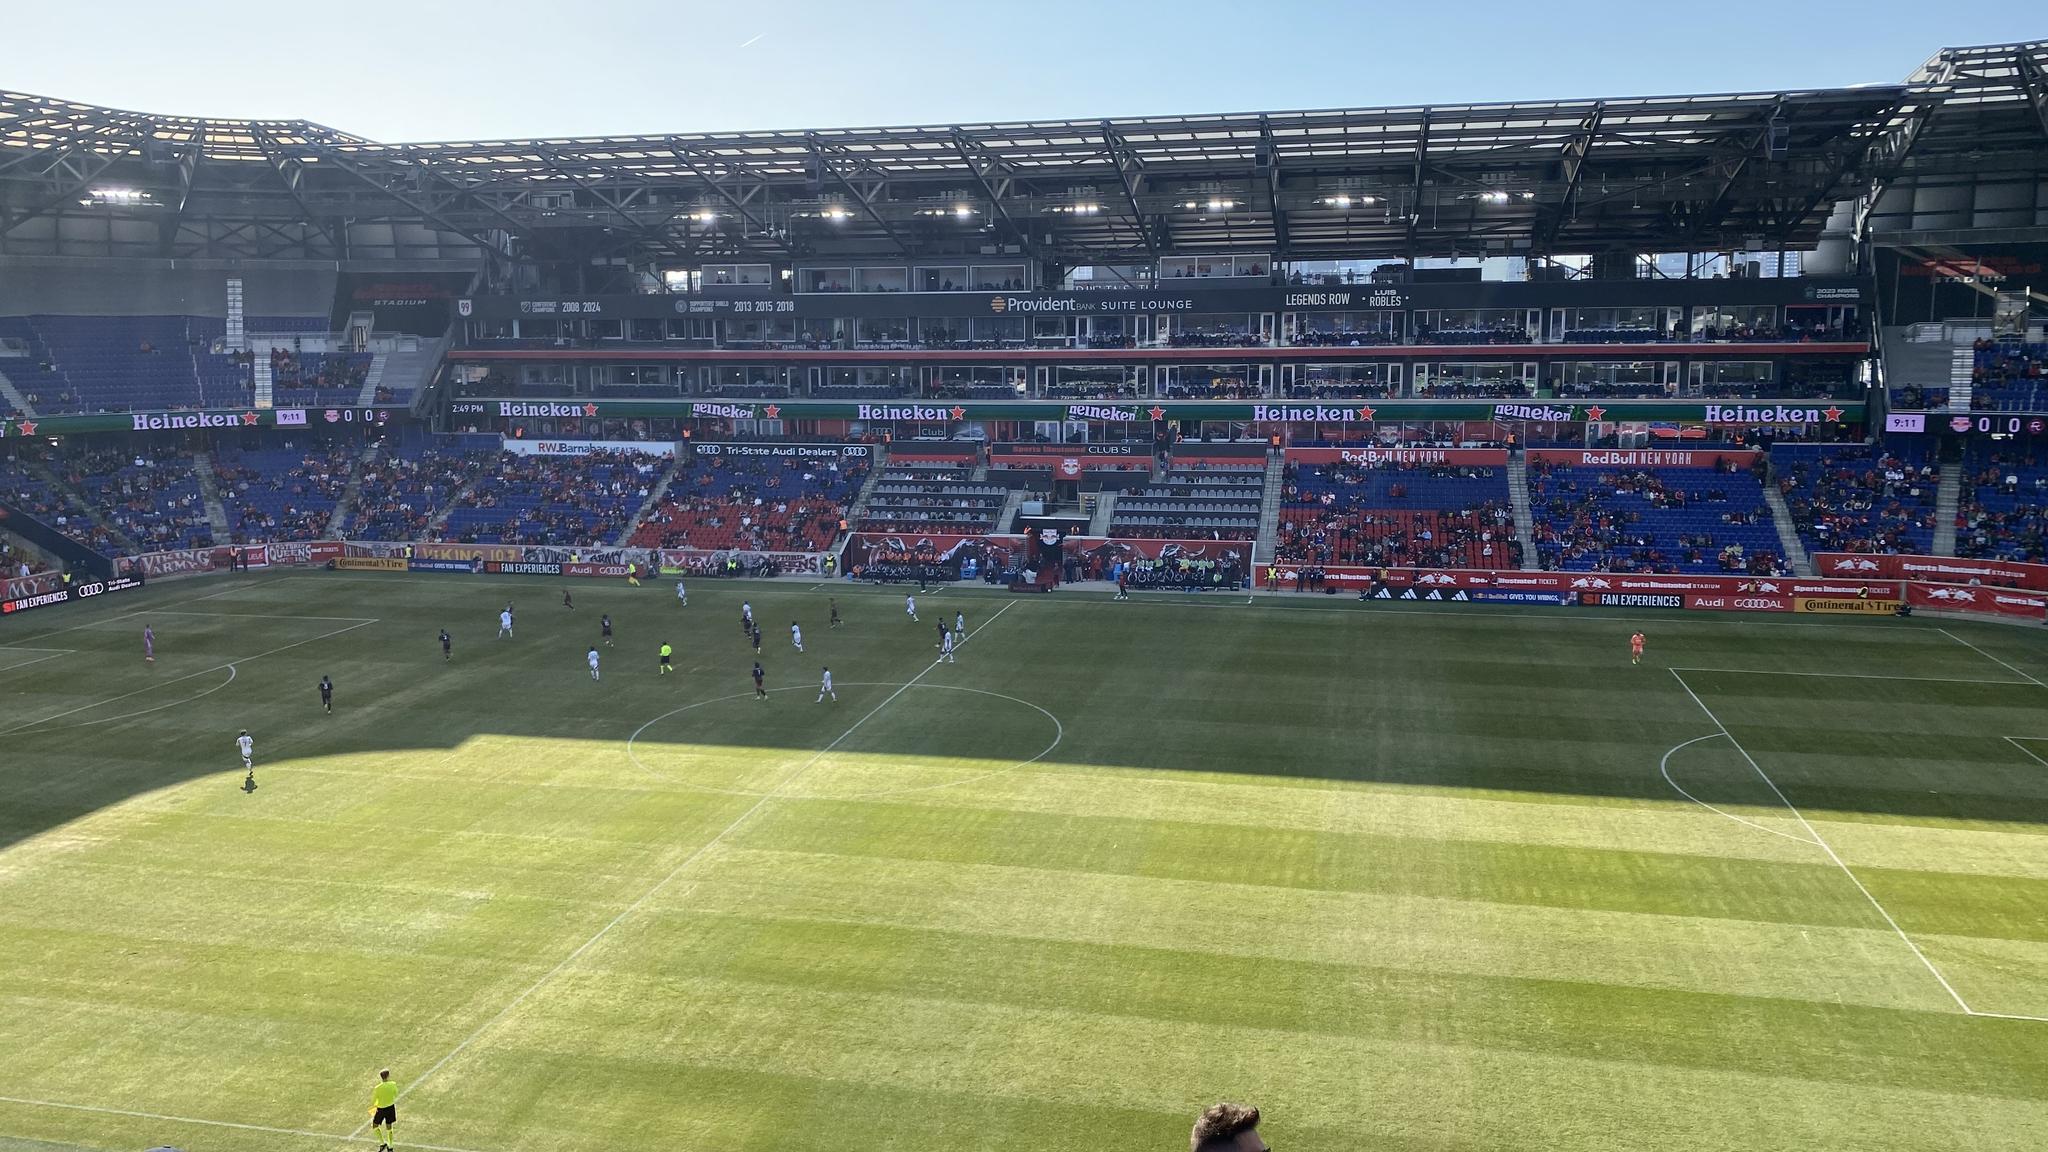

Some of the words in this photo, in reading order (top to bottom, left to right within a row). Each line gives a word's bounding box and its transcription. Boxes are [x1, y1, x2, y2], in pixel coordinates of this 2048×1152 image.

[1007, 296, 1076, 312] Provident
[1286, 293, 1327, 305] LEGENDS
[1328, 293, 1350, 305] ROW
[1369, 296, 1401, 306] ROBLES
[461, 302, 470, 313] 99
[562, 302, 579, 313] 2008
[583, 302, 600, 313] 2024
[734, 301, 752, 312] 2013
[756, 301, 773, 312] 2015
[776, 301, 794, 312] 2018
[1101, 301, 1137, 310] SUITE
[1141, 300, 1193, 309] LOUNGE
[452, 404, 469, 413] 2:49
[471, 404, 484, 413] PM
[500, 402, 582, 417] Heineken
[857, 404, 948, 420] Heineken
[1253, 405, 1355, 421] Heineken
[1704, 405, 1820, 422] Heineken
[132, 411, 240, 431] Heineken
[282, 412, 300, 421] 9:11
[344, 409, 352, 422] 0
[365, 409, 373, 422] 0
[1894, 418, 1916, 427] 9:11
[1978, 417, 1990, 432] 0
[2009, 418, 2020, 433] 0
[921, 428, 944, 436] Club
[726, 446, 770, 455] Tri-State
[772, 447, 796, 456] Audi
[798, 447, 838, 456] Dealers
[1088, 446, 1119, 454] CLUB
[1121, 446, 1131, 454] SI
[1396, 451, 1415, 462] NEW
[1420, 451, 1445, 462] YORK
[1583, 452, 1609, 464] Red
[1610, 452, 1637, 464] Bull
[1640, 452, 1661, 464] NEW
[1665, 452, 1692, 464] YORK
[269, 545, 311, 561] QUEENS
[423, 547, 483, 561] VIKING
[141, 550, 211, 571] VIKING
[339, 559, 379, 568] Continental
[386, 559, 403, 568] Tire
[501, 563, 514, 573] FAN
[515, 563, 560, 574] EXPERIENCES
[570, 566, 593, 574] Audi
[1793, 585, 1823, 593] Sports
[16, 599, 28, 610] FAN
[29, 590, 68, 608] EXPERIENCES
[1583, 593, 1600, 605] SI
[1601, 594, 1618, 605] FAN
[1620, 594, 1680, 607] EXPERIENCES
[1695, 598, 1725, 607] Audi
[1805, 599, 1864, 611] Continental
